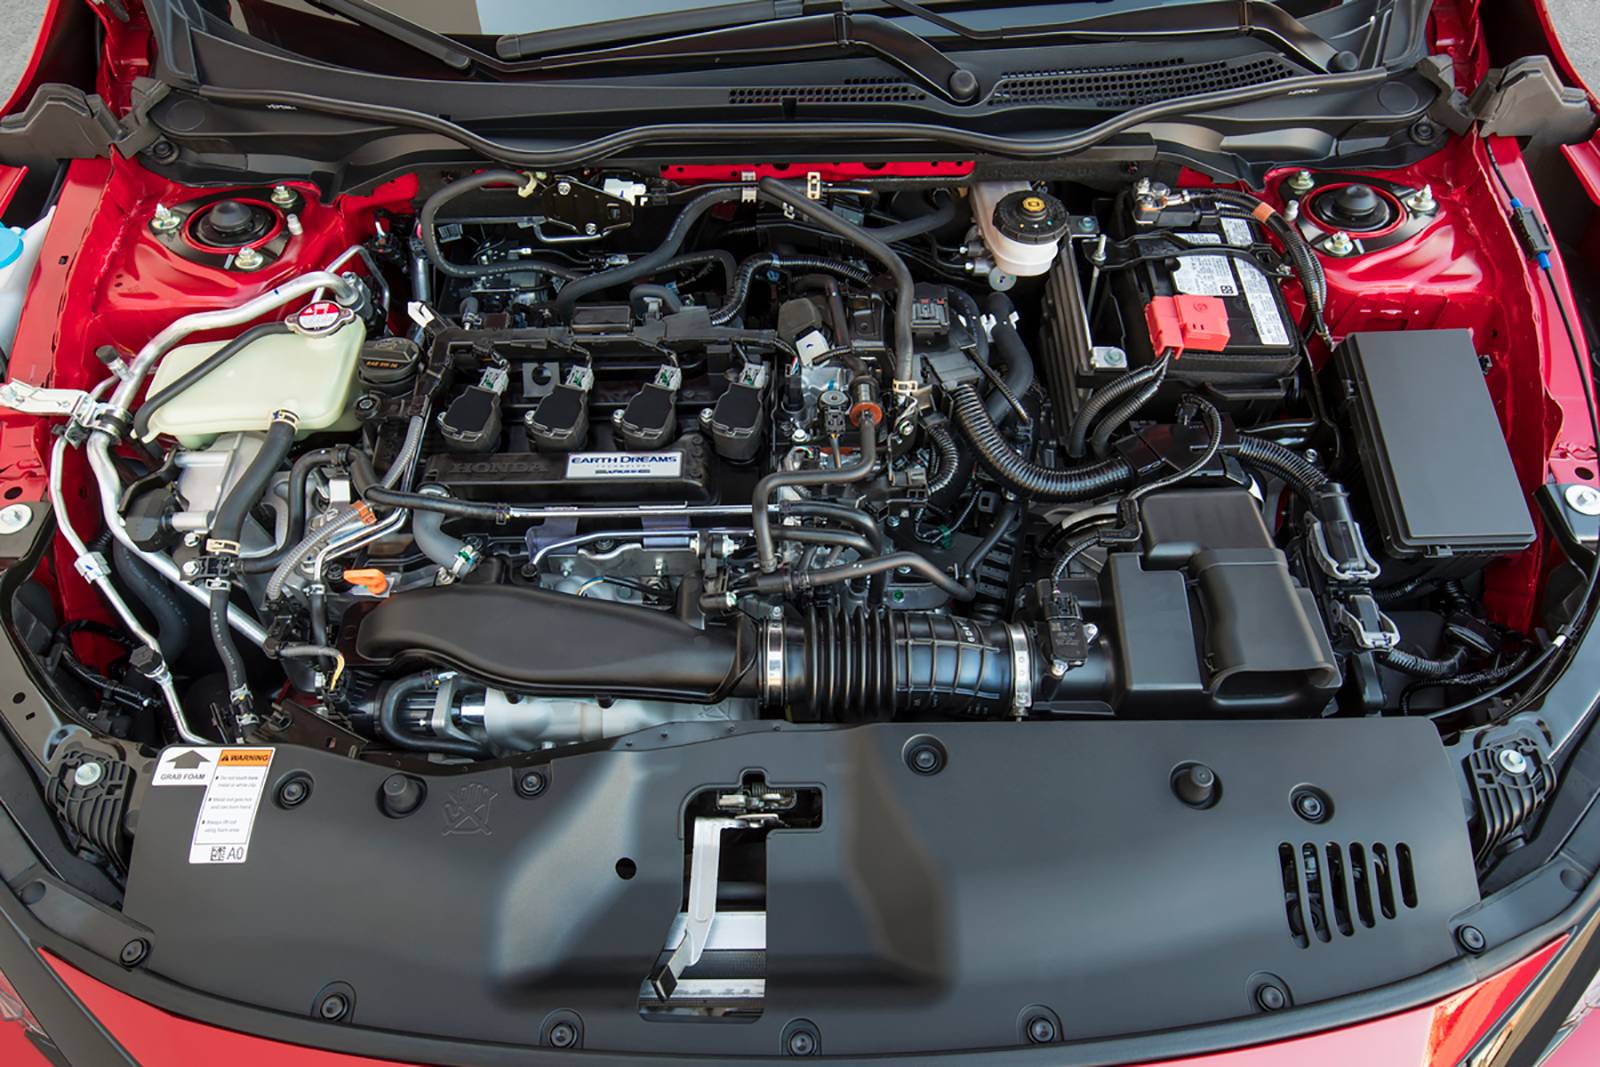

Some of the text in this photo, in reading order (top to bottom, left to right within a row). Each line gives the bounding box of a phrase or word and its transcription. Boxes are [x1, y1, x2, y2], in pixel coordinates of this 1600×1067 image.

[571, 455, 677, 464] EARTH DREAMS
[448, 462, 549, 474] HONDA
[230, 754, 269, 762] WARNING
[226, 846, 245, 860] A0
